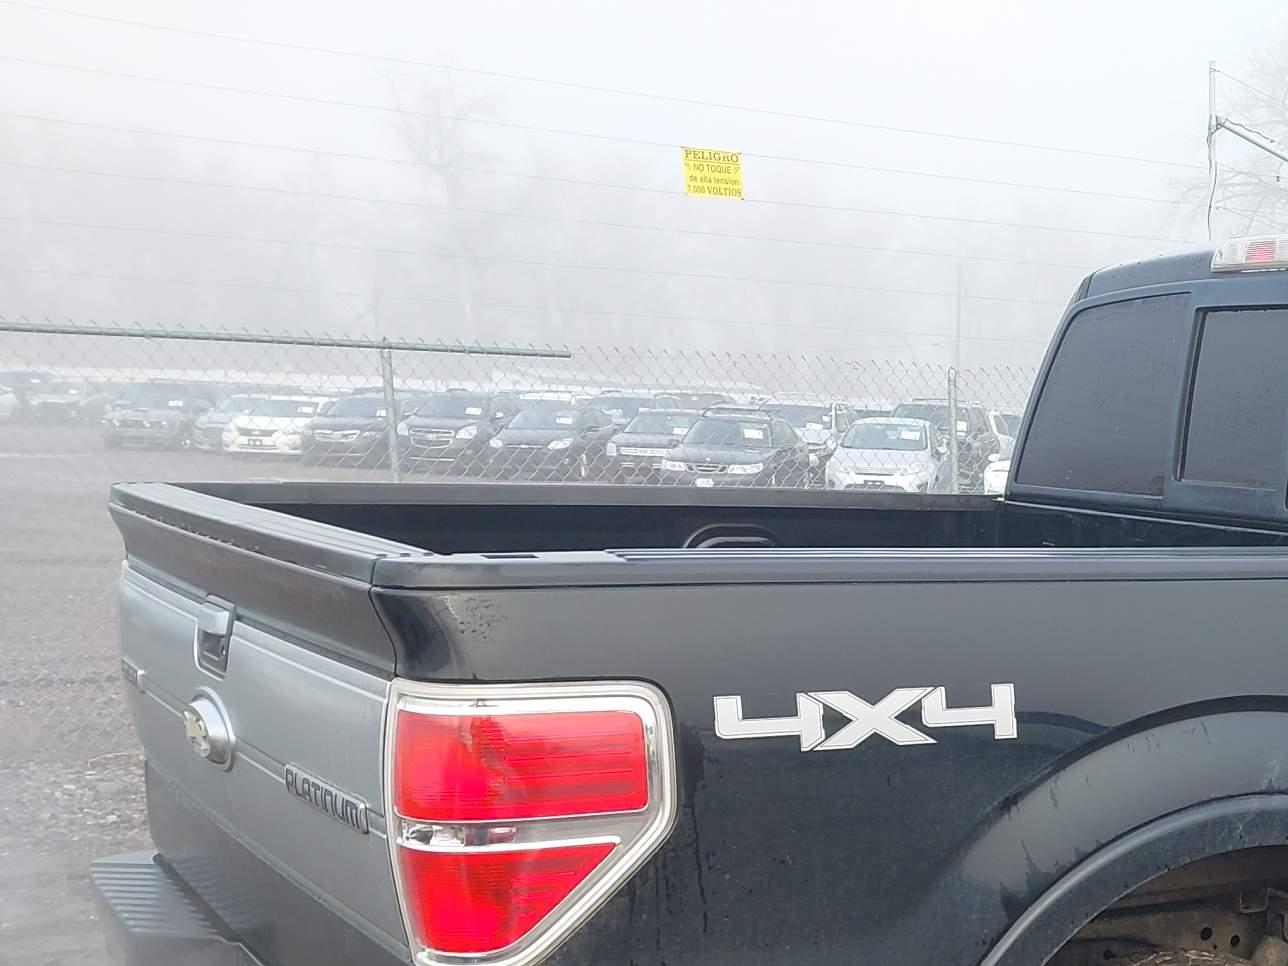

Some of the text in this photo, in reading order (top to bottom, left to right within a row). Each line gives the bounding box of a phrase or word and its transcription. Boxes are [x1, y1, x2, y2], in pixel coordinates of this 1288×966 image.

[685, 149, 739, 162] PELIGRO
[693, 163, 732, 174] NO TOQUE
[707, 186, 742, 197] VOLTIOS
[713, 683, 1017, 752] 4X4
[285, 767, 361, 829] PLATINUM
